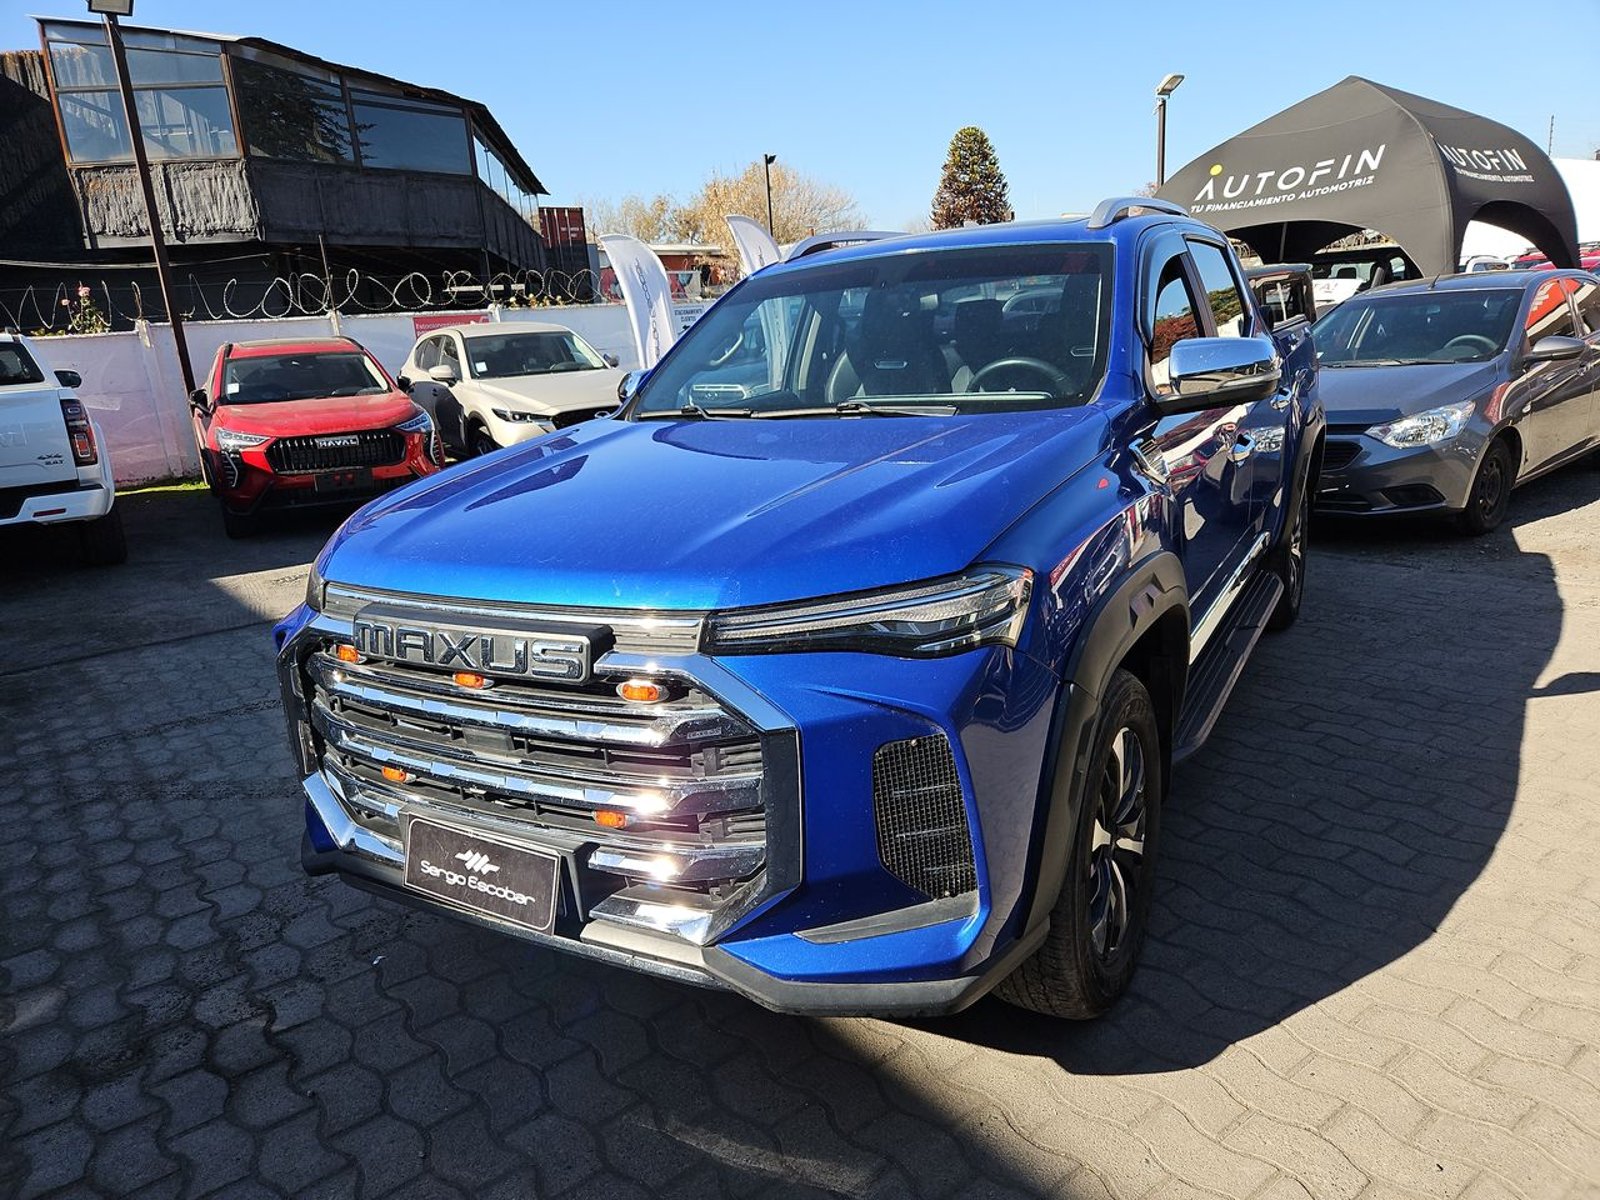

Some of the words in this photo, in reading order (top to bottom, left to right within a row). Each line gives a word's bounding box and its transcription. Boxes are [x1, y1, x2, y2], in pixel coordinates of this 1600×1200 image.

[1194, 145, 1386, 201] AUTOFIN
[1436, 142, 1527, 171] AUTOFIN
[1190, 204, 1204, 214] TU
[1205, 193, 1296, 213] FINANCIAMIENTO
[1298, 175, 1375, 200] AUTOMOTRIZ
[319, 439, 357, 447] HAVAL
[354, 619, 584, 680] MAXUS
[467, 875, 536, 906] Escobar
